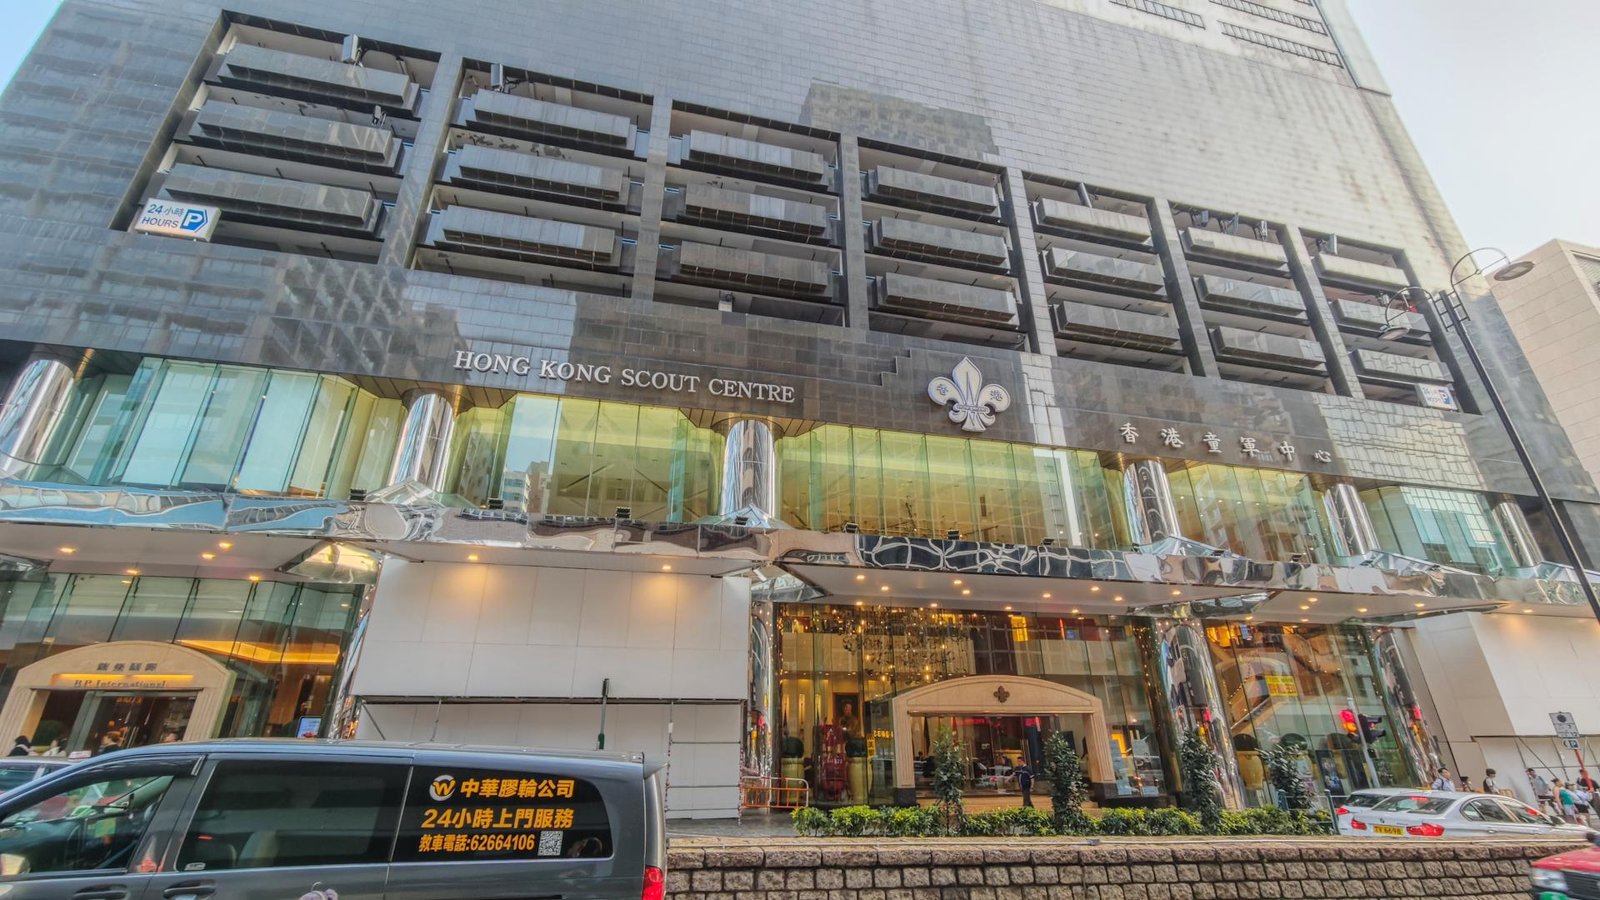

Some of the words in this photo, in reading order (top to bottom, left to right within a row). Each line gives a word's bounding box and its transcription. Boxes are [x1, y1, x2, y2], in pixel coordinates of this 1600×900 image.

[141, 216, 180, 229] HOURS
[453, 351, 531, 376] HONG
[539, 359, 613, 385] KONG
[621, 368, 700, 393] SCOUT
[708, 378, 796, 403] CENTRE
[1120, 422, 1332, 463] 香港童軍中心
[95, 679, 166, 688] International
[460, 778, 575, 798] 中華膠輪公司
[421, 808, 574, 829] 24小時上門服務
[418, 834, 535, 852] 救車電話:62664106
